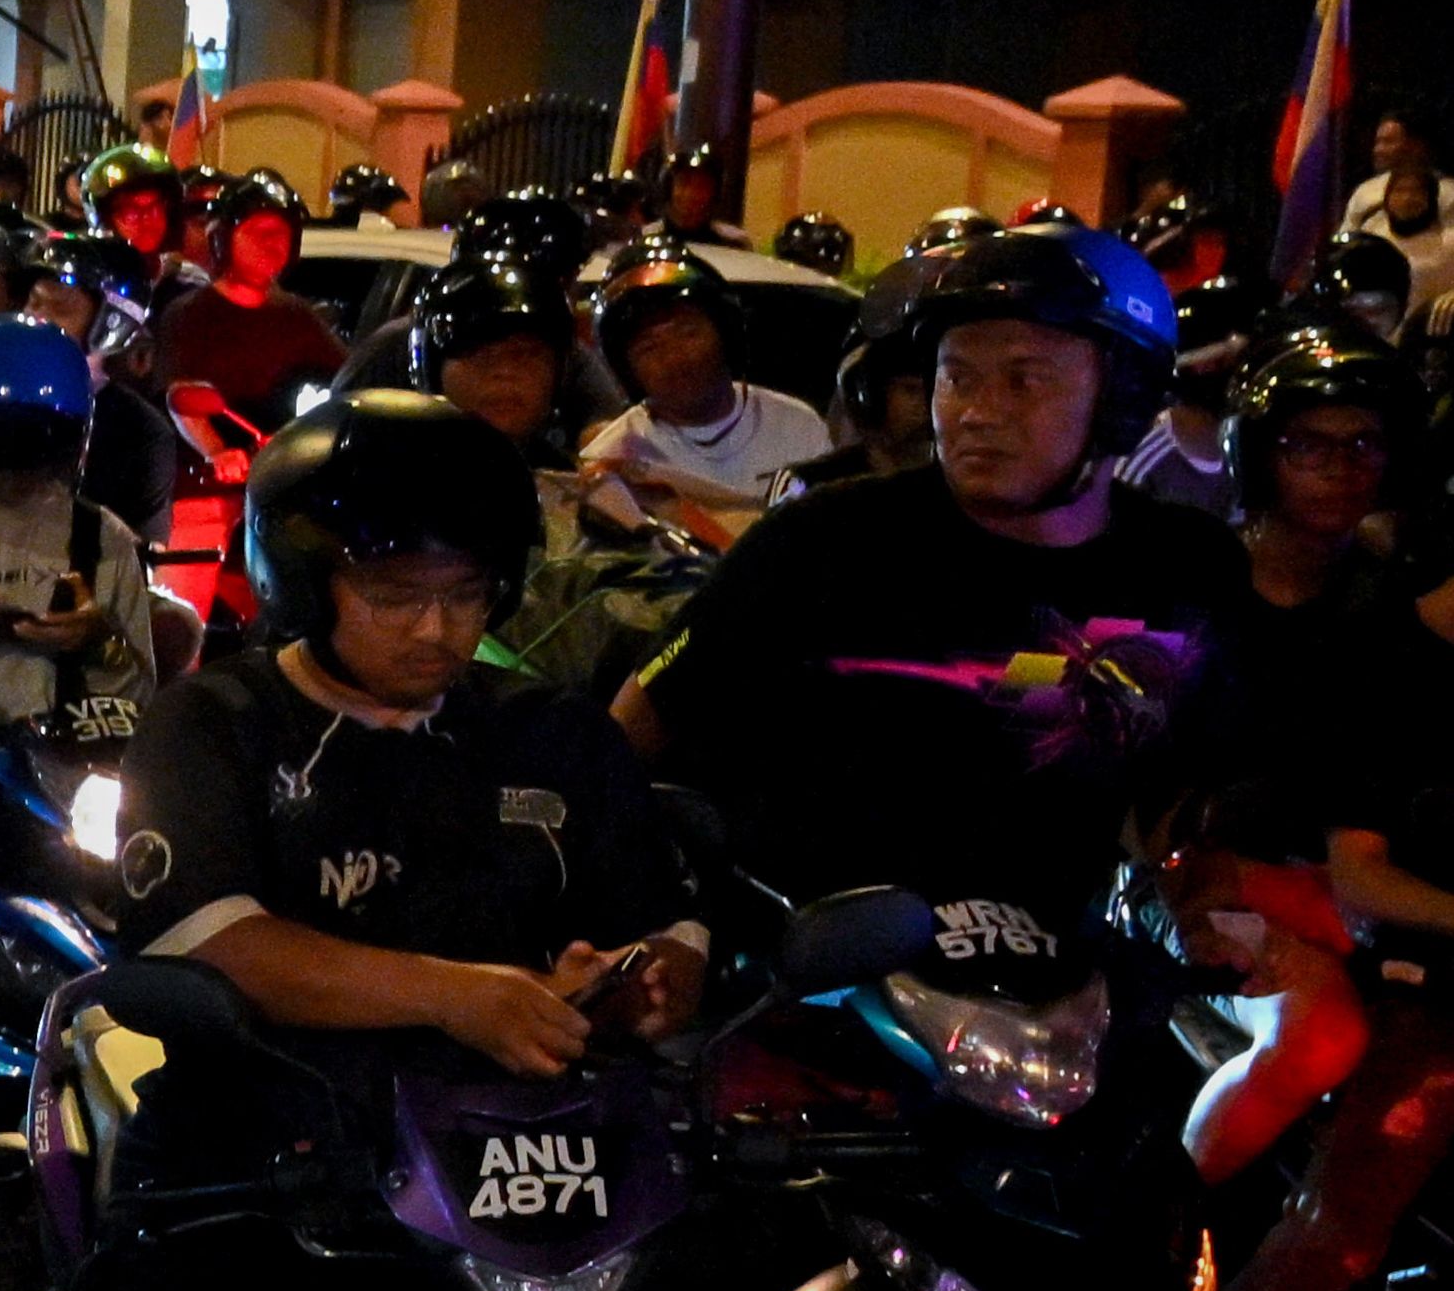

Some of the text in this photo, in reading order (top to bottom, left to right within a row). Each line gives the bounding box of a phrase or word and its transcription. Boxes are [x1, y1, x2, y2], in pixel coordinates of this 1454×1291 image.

[935, 924, 1059, 960] 5767
[479, 1133, 597, 1177] ANU
[469, 1173, 608, 1219] 4871
